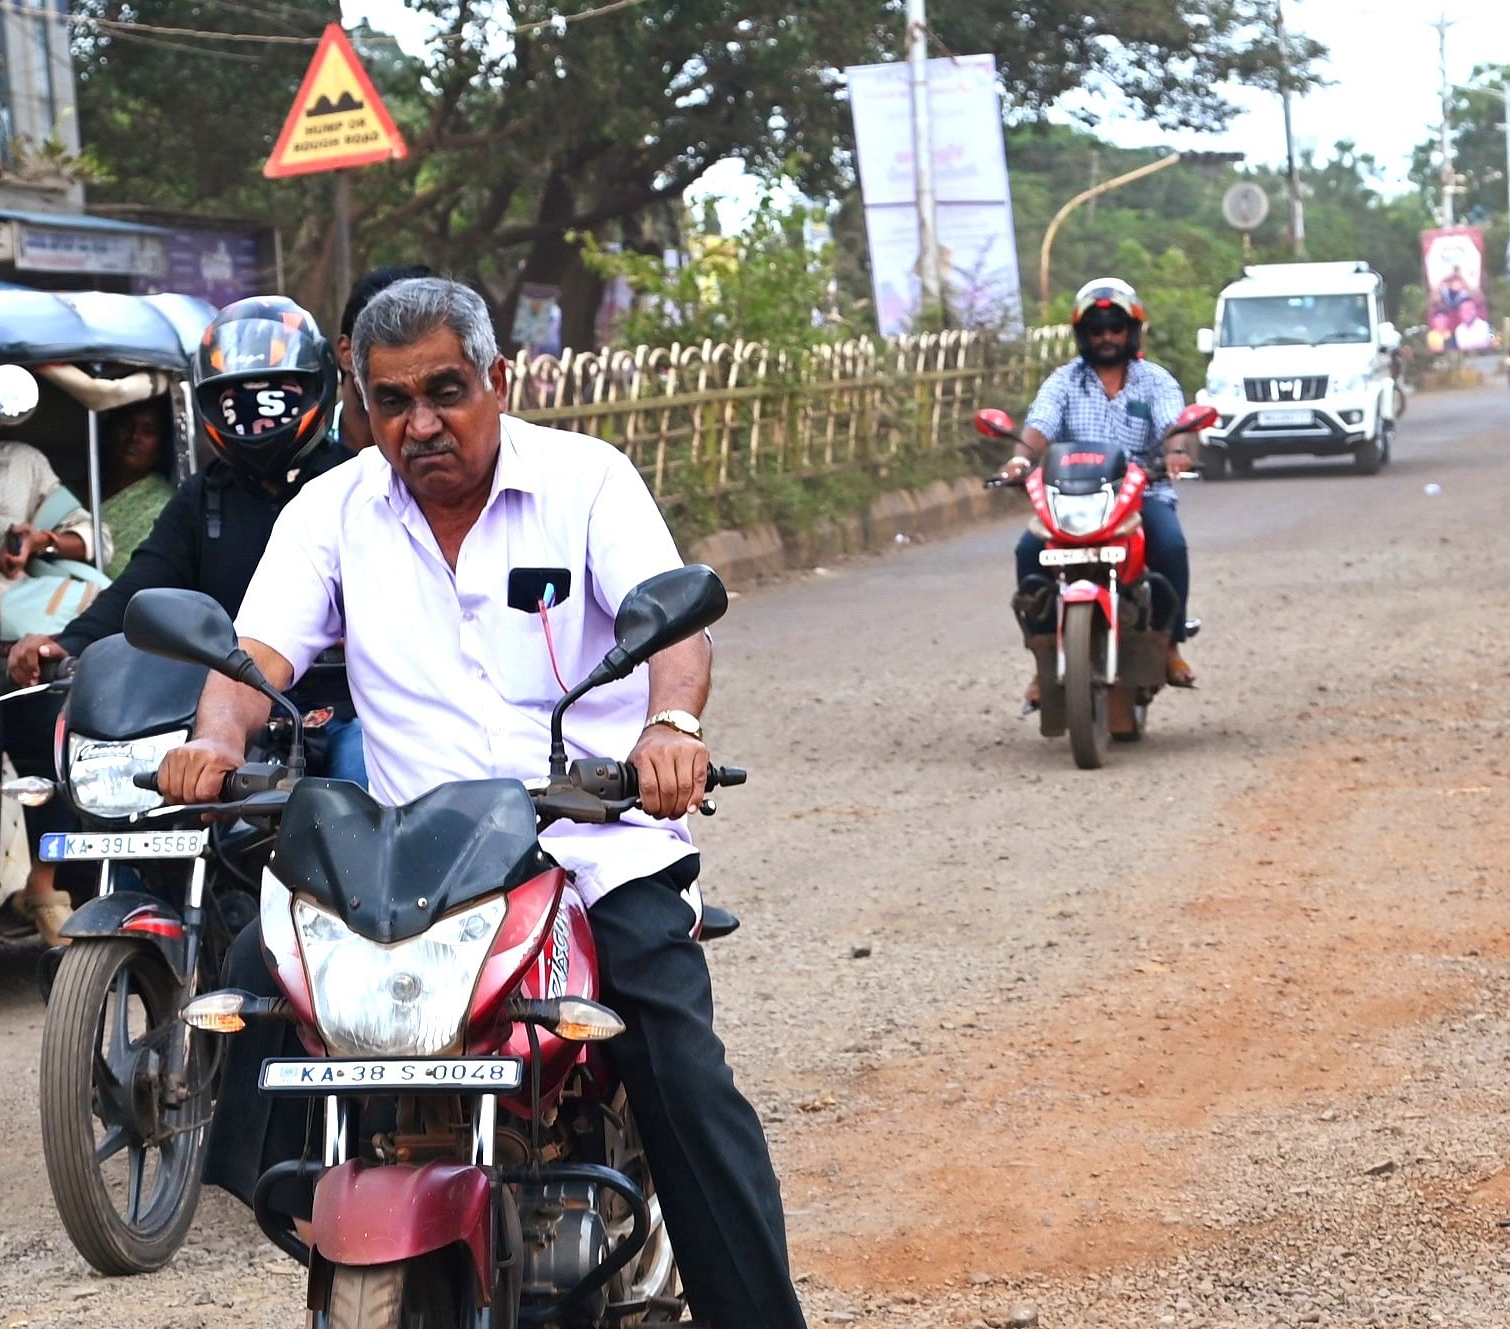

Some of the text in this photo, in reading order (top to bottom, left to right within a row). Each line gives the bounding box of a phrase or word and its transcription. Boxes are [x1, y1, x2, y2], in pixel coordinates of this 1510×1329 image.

[304, 120, 342, 136] HUMP
[293, 130, 380, 153] ROUGH ROAD
[66, 838, 88, 855] KA
[152, 835, 198, 853] 5568
[301, 1064, 505, 1083] KA 38 S 0048
